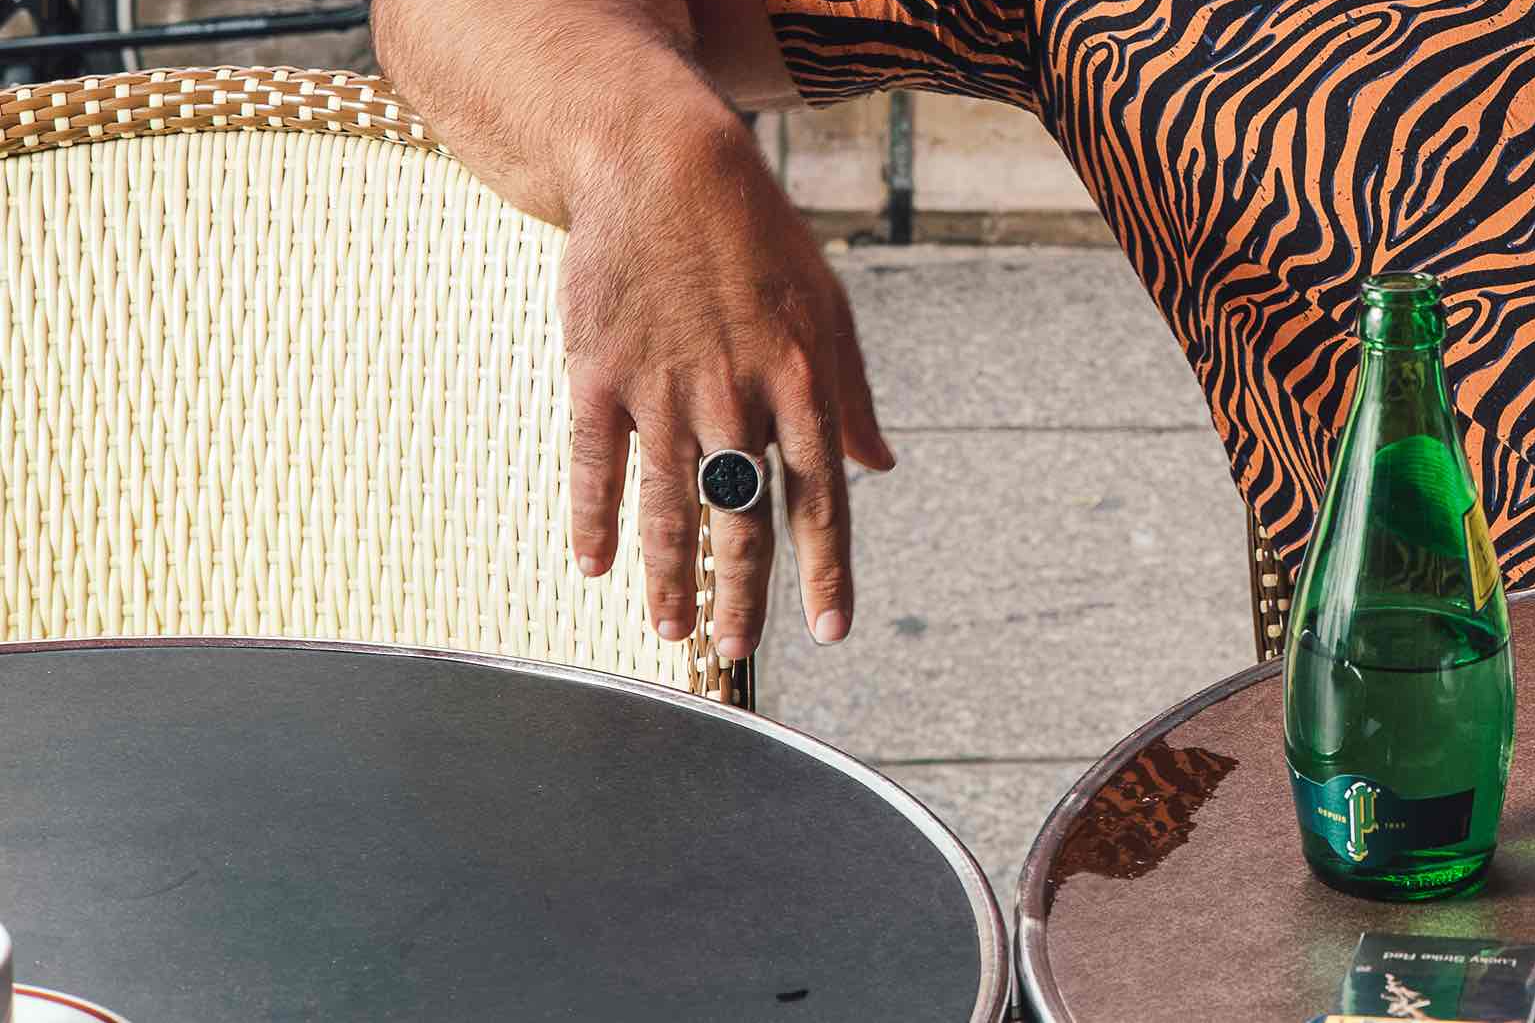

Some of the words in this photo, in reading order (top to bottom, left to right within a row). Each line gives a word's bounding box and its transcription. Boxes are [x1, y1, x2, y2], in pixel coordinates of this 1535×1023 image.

[1383, 951, 1417, 961] Red
[1420, 952, 1465, 964] Strike
[1469, 955, 1518, 968] Lucky
